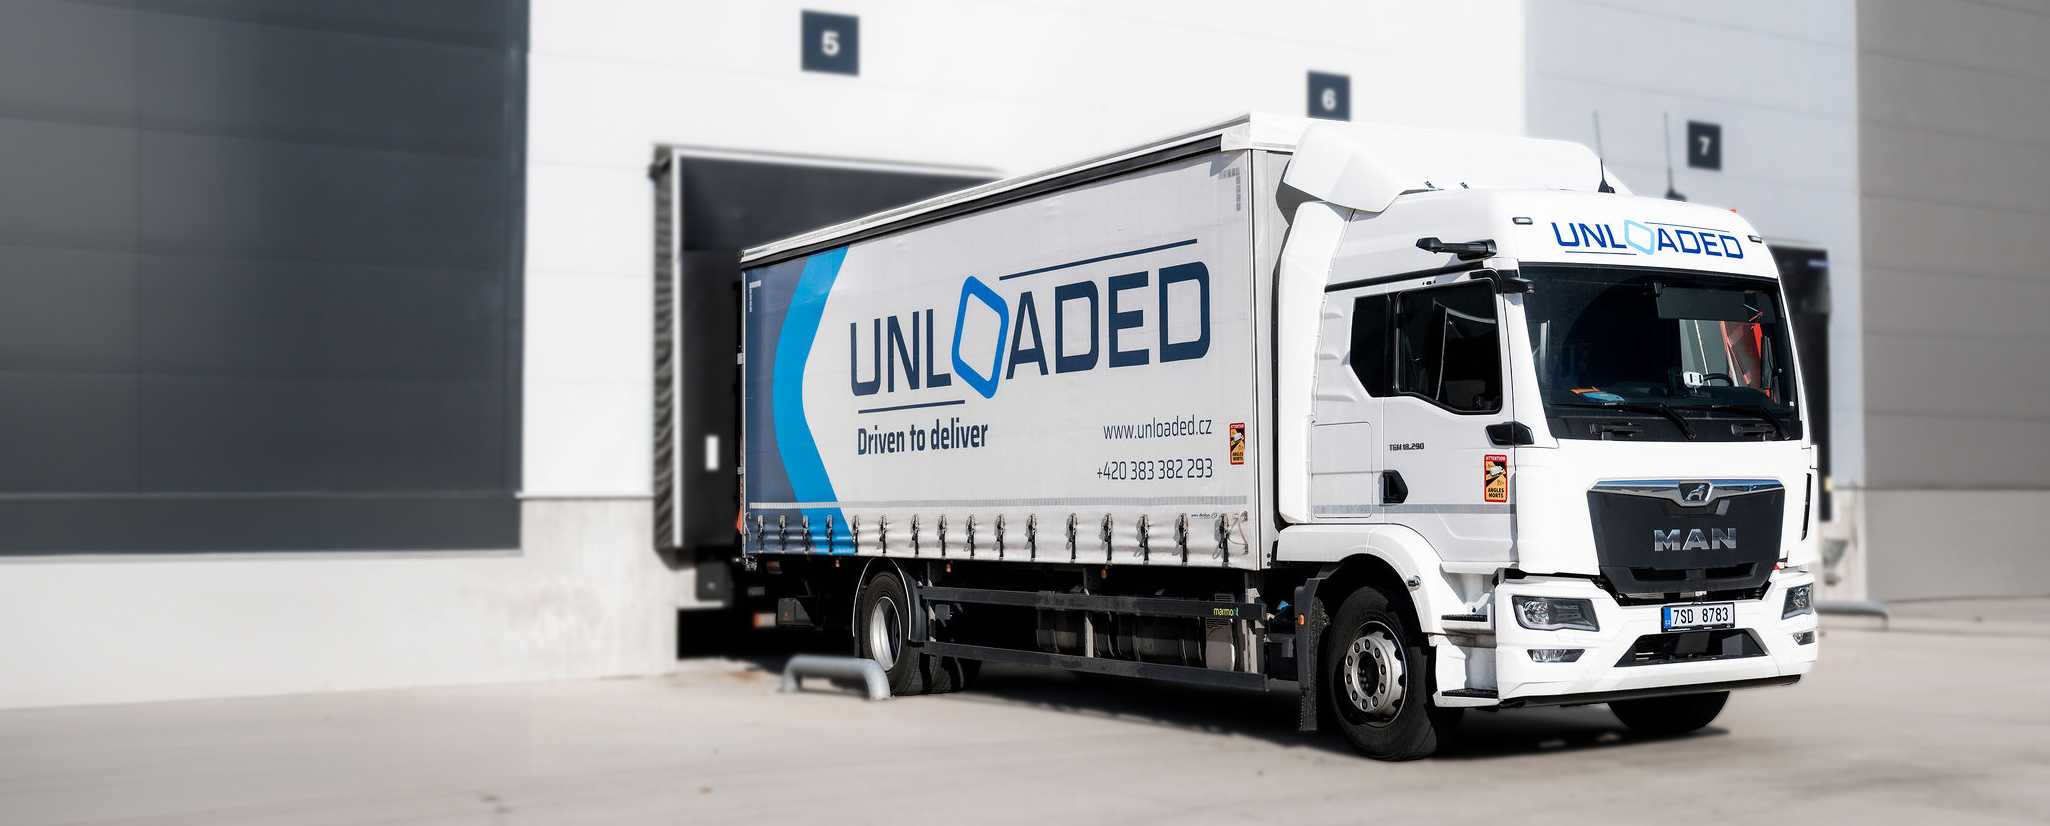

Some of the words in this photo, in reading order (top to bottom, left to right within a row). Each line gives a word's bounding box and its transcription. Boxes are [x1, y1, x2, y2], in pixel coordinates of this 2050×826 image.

[822, 30, 841, 56] 5
[1321, 88, 1337, 111] 6
[1699, 136, 1711, 156] 7
[1551, 219, 1744, 259] UNLOADED
[850, 261, 1211, 399] UNLOADED
[858, 425, 905, 455] Driven
[910, 424, 926, 451] to
[930, 417, 989, 450] deliver
[1103, 414, 1212, 439] www.unloaded.cz
[1097, 461, 1127, 480] +420
[1130, 461, 1154, 480] 383
[1158, 459, 1183, 479] 382
[1187, 458, 1213, 478] 293
[1654, 527, 1737, 552] MAN
[1673, 608, 1694, 624] 7SD
[1702, 607, 1729, 623] 8783
